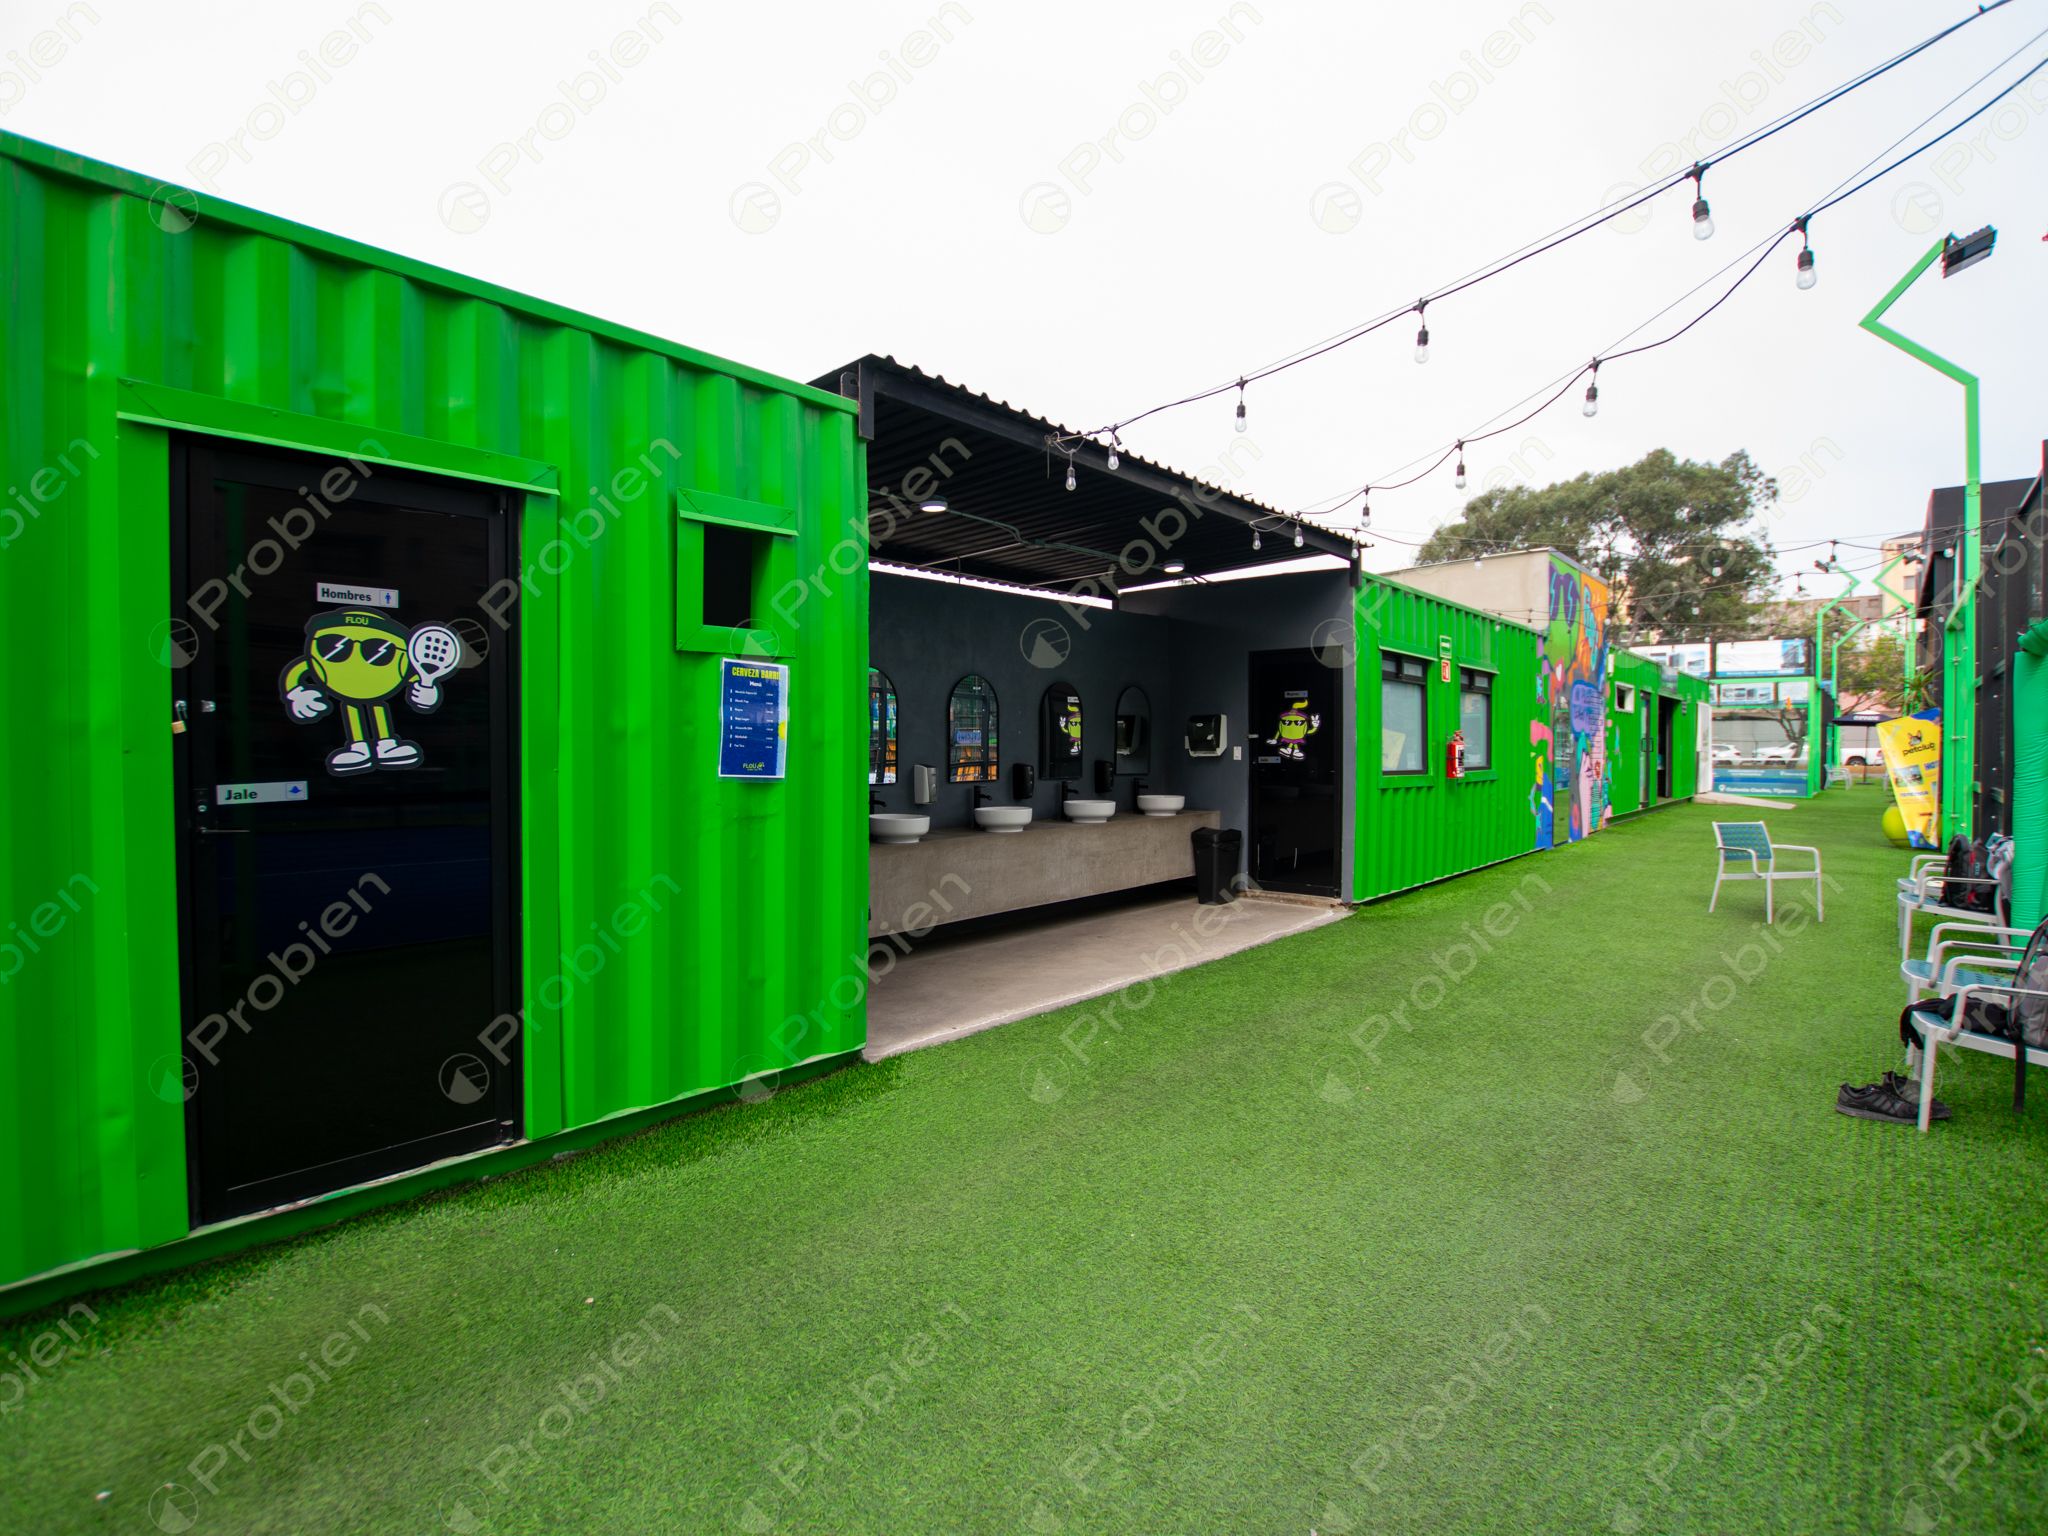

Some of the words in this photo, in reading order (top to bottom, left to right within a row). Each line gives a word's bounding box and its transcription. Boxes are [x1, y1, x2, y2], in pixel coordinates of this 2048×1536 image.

[321, 588, 372, 602] Hombres
[732, 666, 760, 678] CERVEZA
[1902, 742, 1935, 757] petclub
[225, 789, 258, 801] Jale
